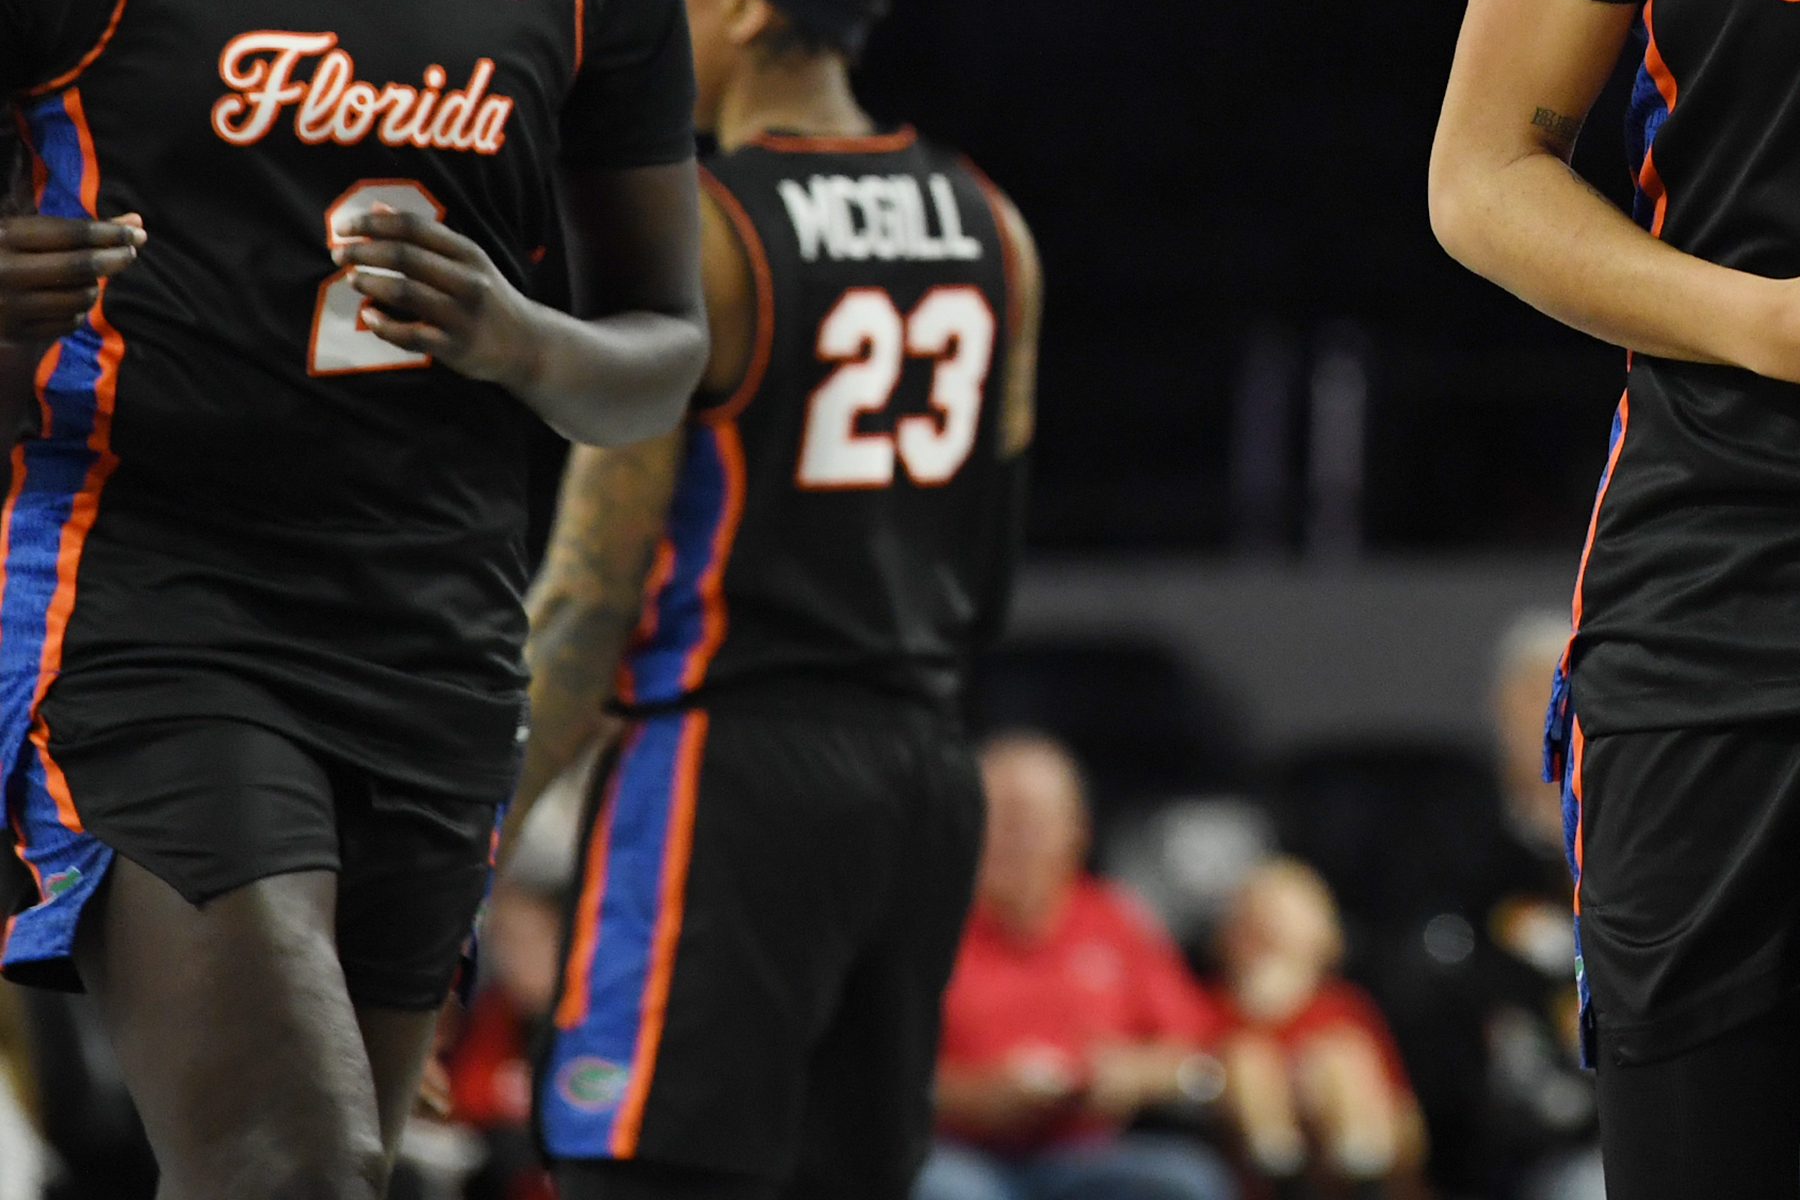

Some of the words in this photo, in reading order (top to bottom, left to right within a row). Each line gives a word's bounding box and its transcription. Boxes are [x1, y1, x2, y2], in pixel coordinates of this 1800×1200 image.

[211, 29, 514, 156] Florida
[775, 172, 984, 263] MCGILL
[793, 283, 998, 492] 23
